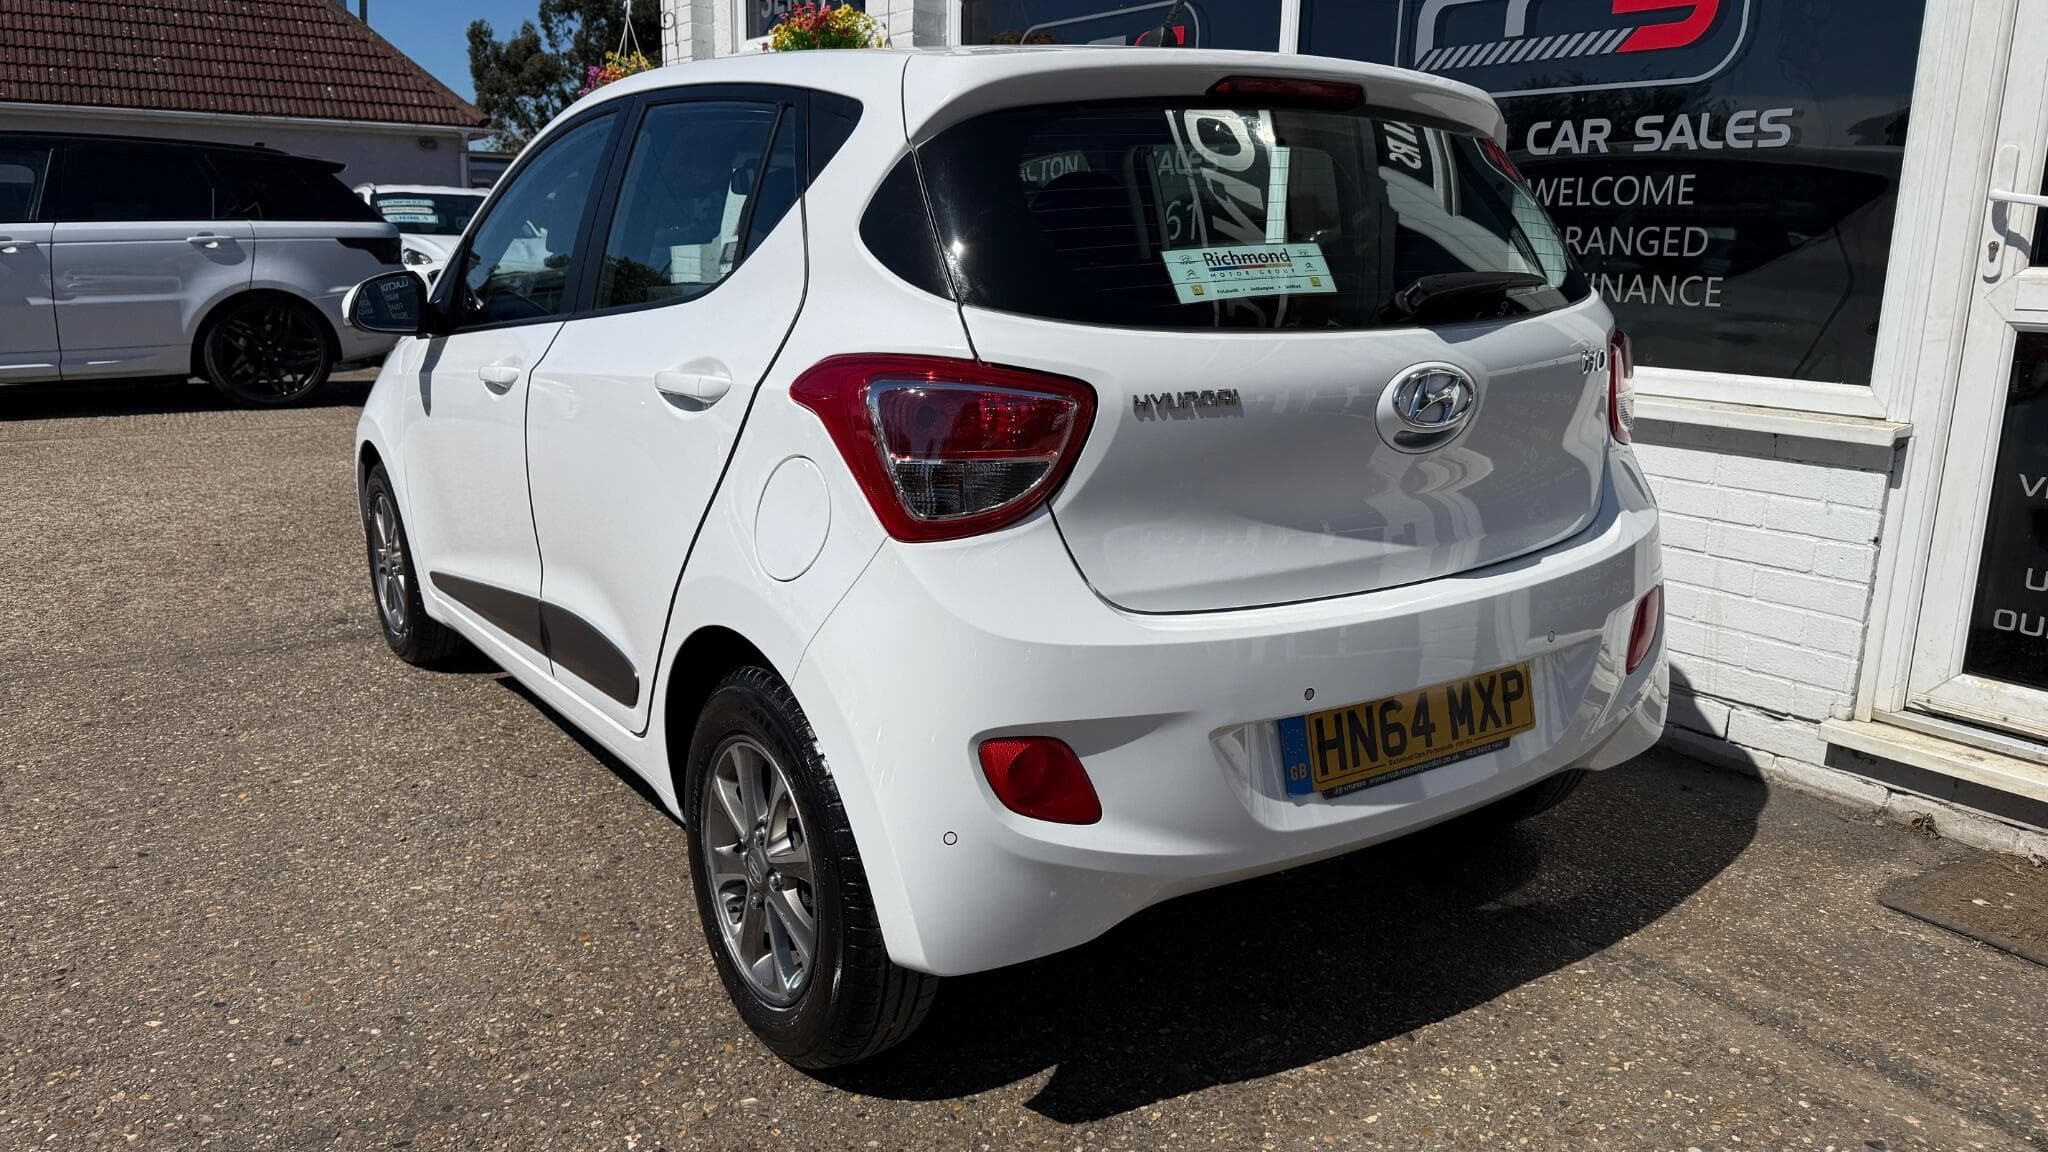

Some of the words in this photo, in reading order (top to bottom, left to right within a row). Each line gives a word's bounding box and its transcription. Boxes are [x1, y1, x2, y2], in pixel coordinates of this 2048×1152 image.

[1526, 118, 1612, 155] CAR
[1633, 107, 1793, 152] SALES
[1527, 174, 1696, 207] WELCOME
[1558, 226, 1708, 257] RANGED
[1202, 248, 1292, 267] Richmond
[1210, 269, 1250, 278] MOTOR
[1259, 267, 1296, 276] GROUP
[1584, 272, 1724, 308] INANCE
[1993, 608, 2048, 639] OU
[1314, 691, 1436, 777] HN64
[1446, 669, 1525, 741] MXP
[1290, 763, 1307, 781] GB
